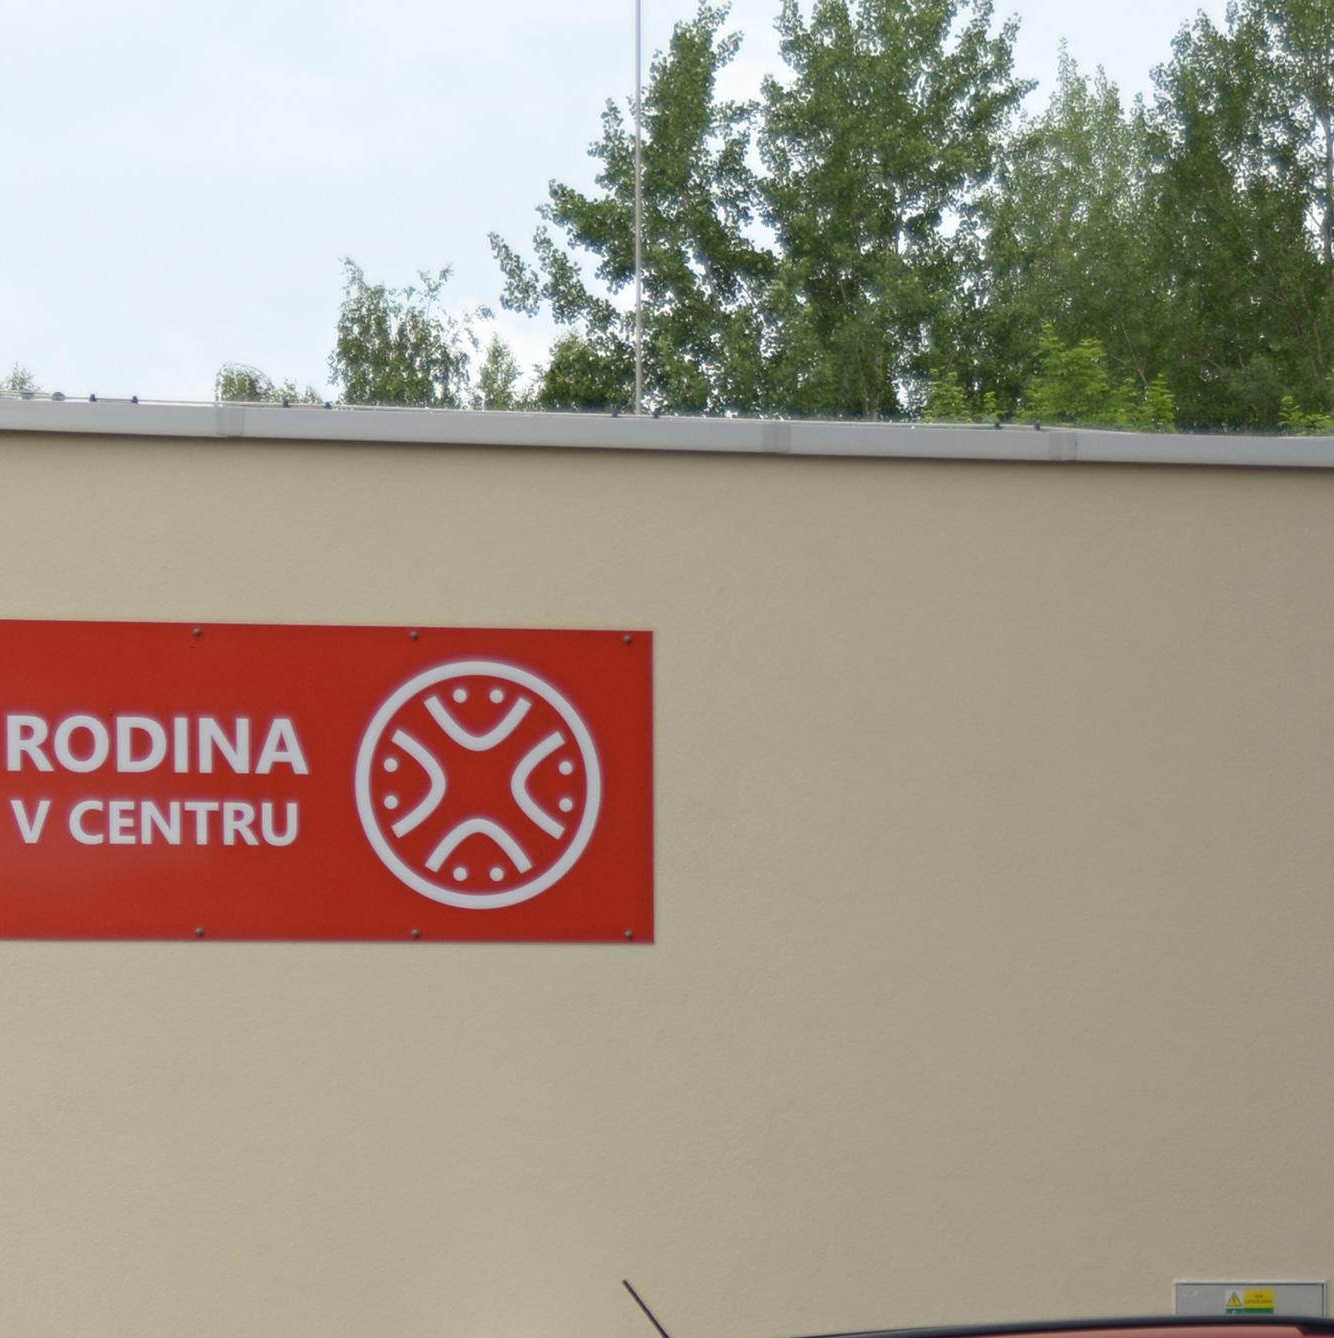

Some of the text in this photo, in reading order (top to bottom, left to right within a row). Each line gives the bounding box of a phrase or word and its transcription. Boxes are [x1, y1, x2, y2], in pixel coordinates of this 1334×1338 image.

[6, 714, 309, 775] RODINA
[10, 799, 299, 847] V CENTRU
